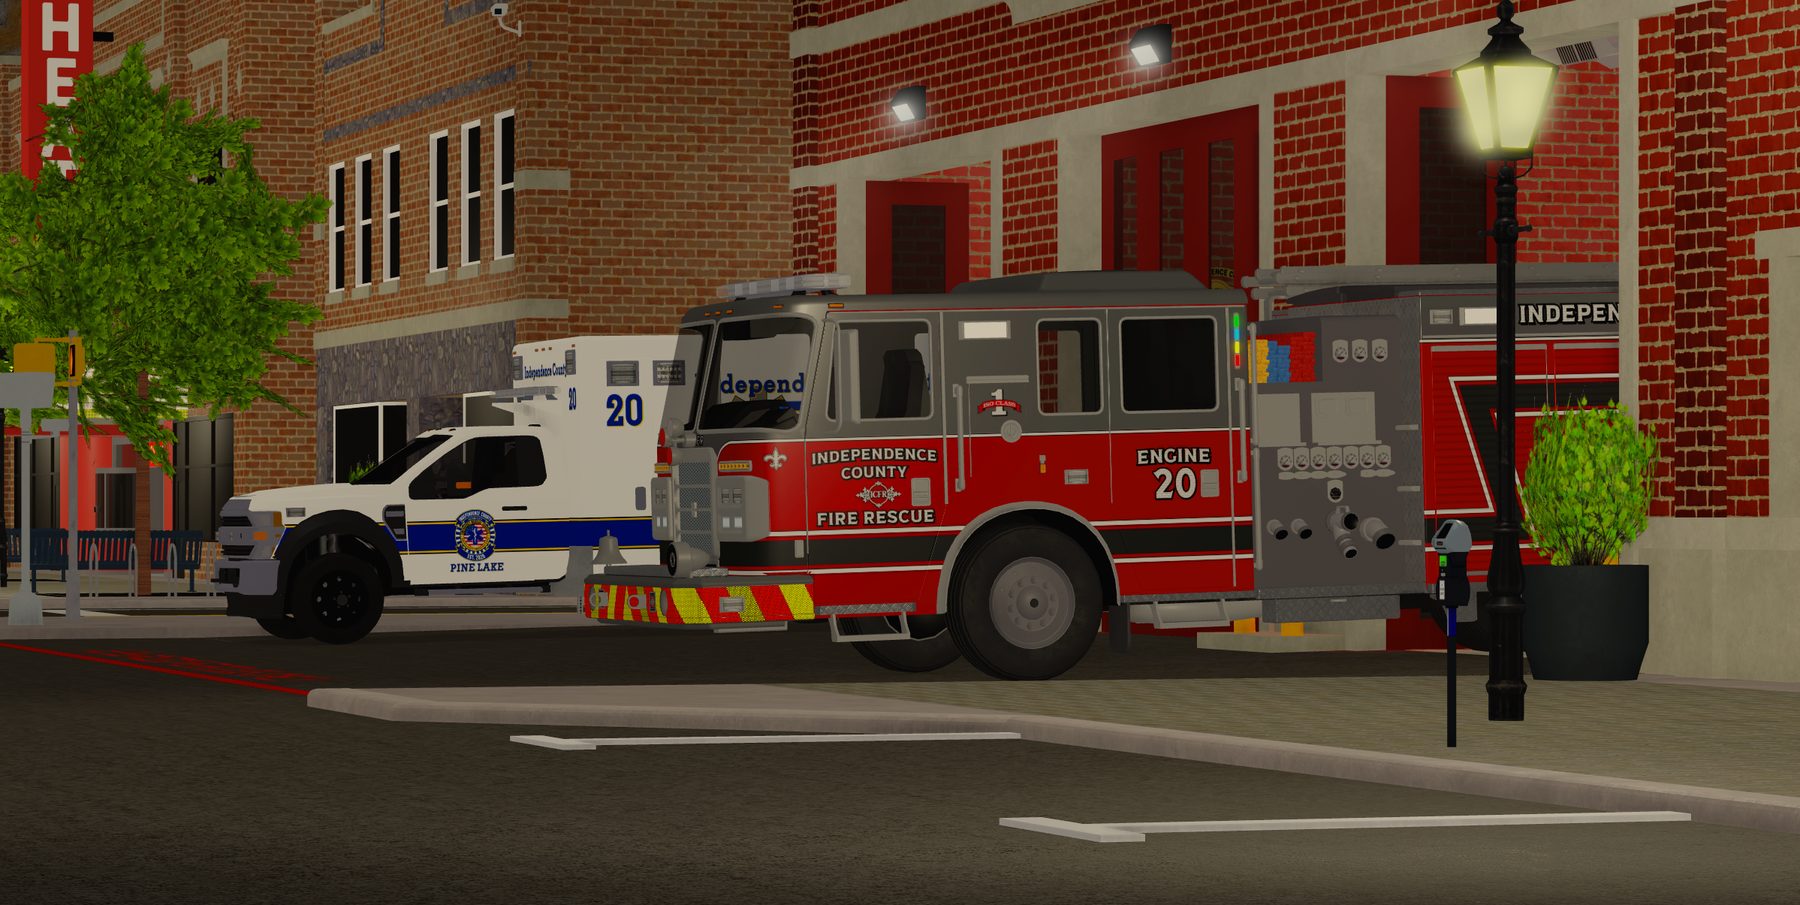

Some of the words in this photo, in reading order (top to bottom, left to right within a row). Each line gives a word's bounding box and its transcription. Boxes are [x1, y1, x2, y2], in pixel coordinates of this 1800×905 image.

[524, 364, 552, 381] Independence
[568, 387, 577, 411] 20
[606, 393, 644, 427] 20
[811, 448, 938, 466] INDEPENDENCE
[1136, 447, 1212, 466] ENGINE
[841, 465, 908, 480] COUNTY
[1153, 467, 1197, 500] 20
[816, 511, 859, 527] FIRE
[863, 509, 935, 526] RESCUE
[450, 563, 475, 572] PINE
[477, 562, 504, 572] LAKE
